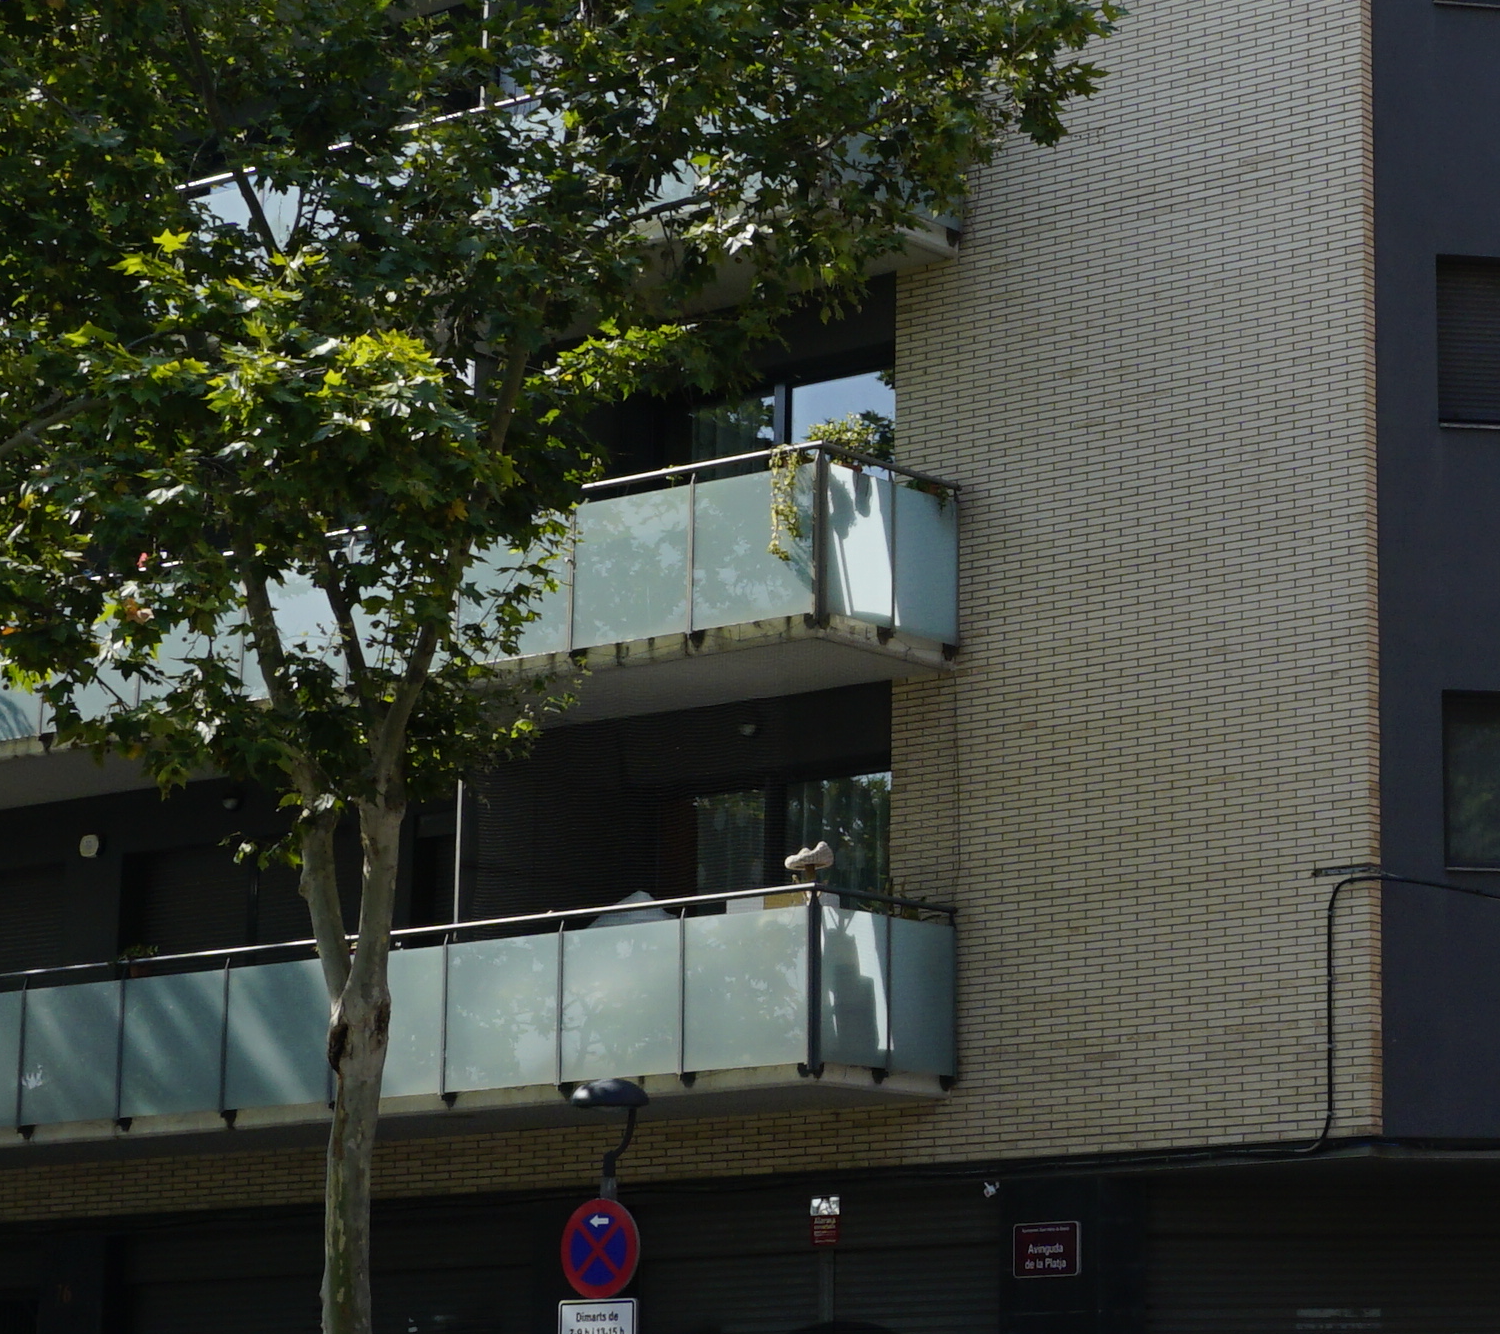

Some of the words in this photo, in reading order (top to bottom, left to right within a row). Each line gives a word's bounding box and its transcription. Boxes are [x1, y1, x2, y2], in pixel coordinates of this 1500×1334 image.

[1028, 1243, 1064, 1256] Avinguda
[1024, 1258, 1035, 1270] de
[1036, 1258, 1044, 1269] la
[1045, 1257, 1067, 1271] Platja
[575, 1312, 607, 1323] Dimarts
[608, 1311, 619, 1322] de
